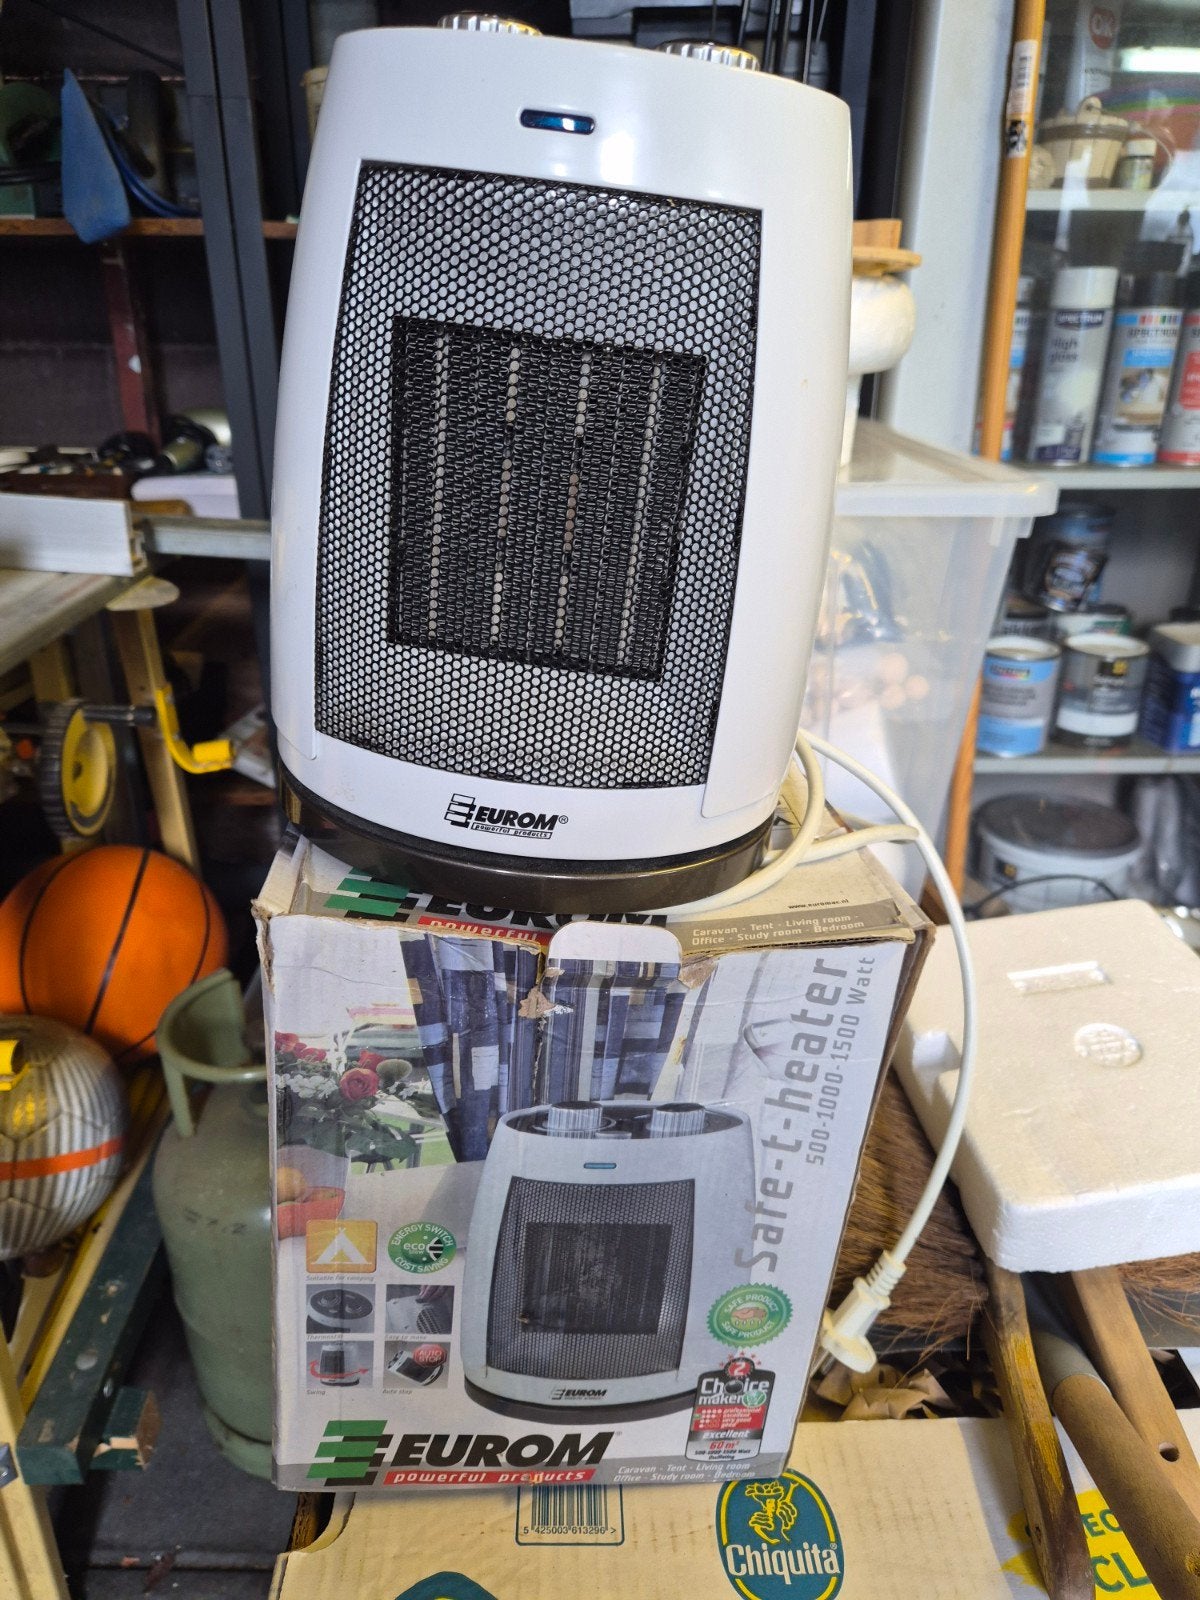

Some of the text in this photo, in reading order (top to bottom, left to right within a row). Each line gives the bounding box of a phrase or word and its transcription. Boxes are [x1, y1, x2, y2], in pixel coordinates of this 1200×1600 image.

[474, 805, 560, 831] EUROM
[475, 825, 549, 838] powerful products
[692, 936, 725, 946] Office
[737, 932, 769, 942] Study
[773, 928, 802, 937] room
[814, 921, 865, 933] Bedroom
[693, 926, 738, 937] Caravan
[751, 922, 774, 931] Tent
[786, 918, 820, 927] Living
[823, 915, 851, 923] room
[806, 956, 876, 1166] 500-1000-1500 Watt
[734, 958, 848, 1273] Safe-t-heater
[391, 1224, 454, 1247] ENERGY SWITCH
[403, 1243, 426, 1251] eco
[394, 1256, 449, 1273] COST SAVING
[733, 1361, 746, 1376] 2
[564, 1388, 608, 1397] EUROM
[703, 1430, 751, 1439] excellent
[390, 1432, 615, 1467] EUROM
[710, 1441, 724, 1450] 60
[613, 1474, 641, 1482] Office
[650, 1473, 678, 1482] Study
[714, 1470, 756, 1479] Bedroom
[618, 1465, 656, 1474] Caravan
[696, 1463, 723, 1472] Living
[393, 1472, 486, 1484] powerful
[523, 1526, 529, 1534] 5
[534, 1526, 569, 1534] 425003
[571, 1526, 606, 1534] 613296
[725, 1541, 841, 1585] Chiquita
